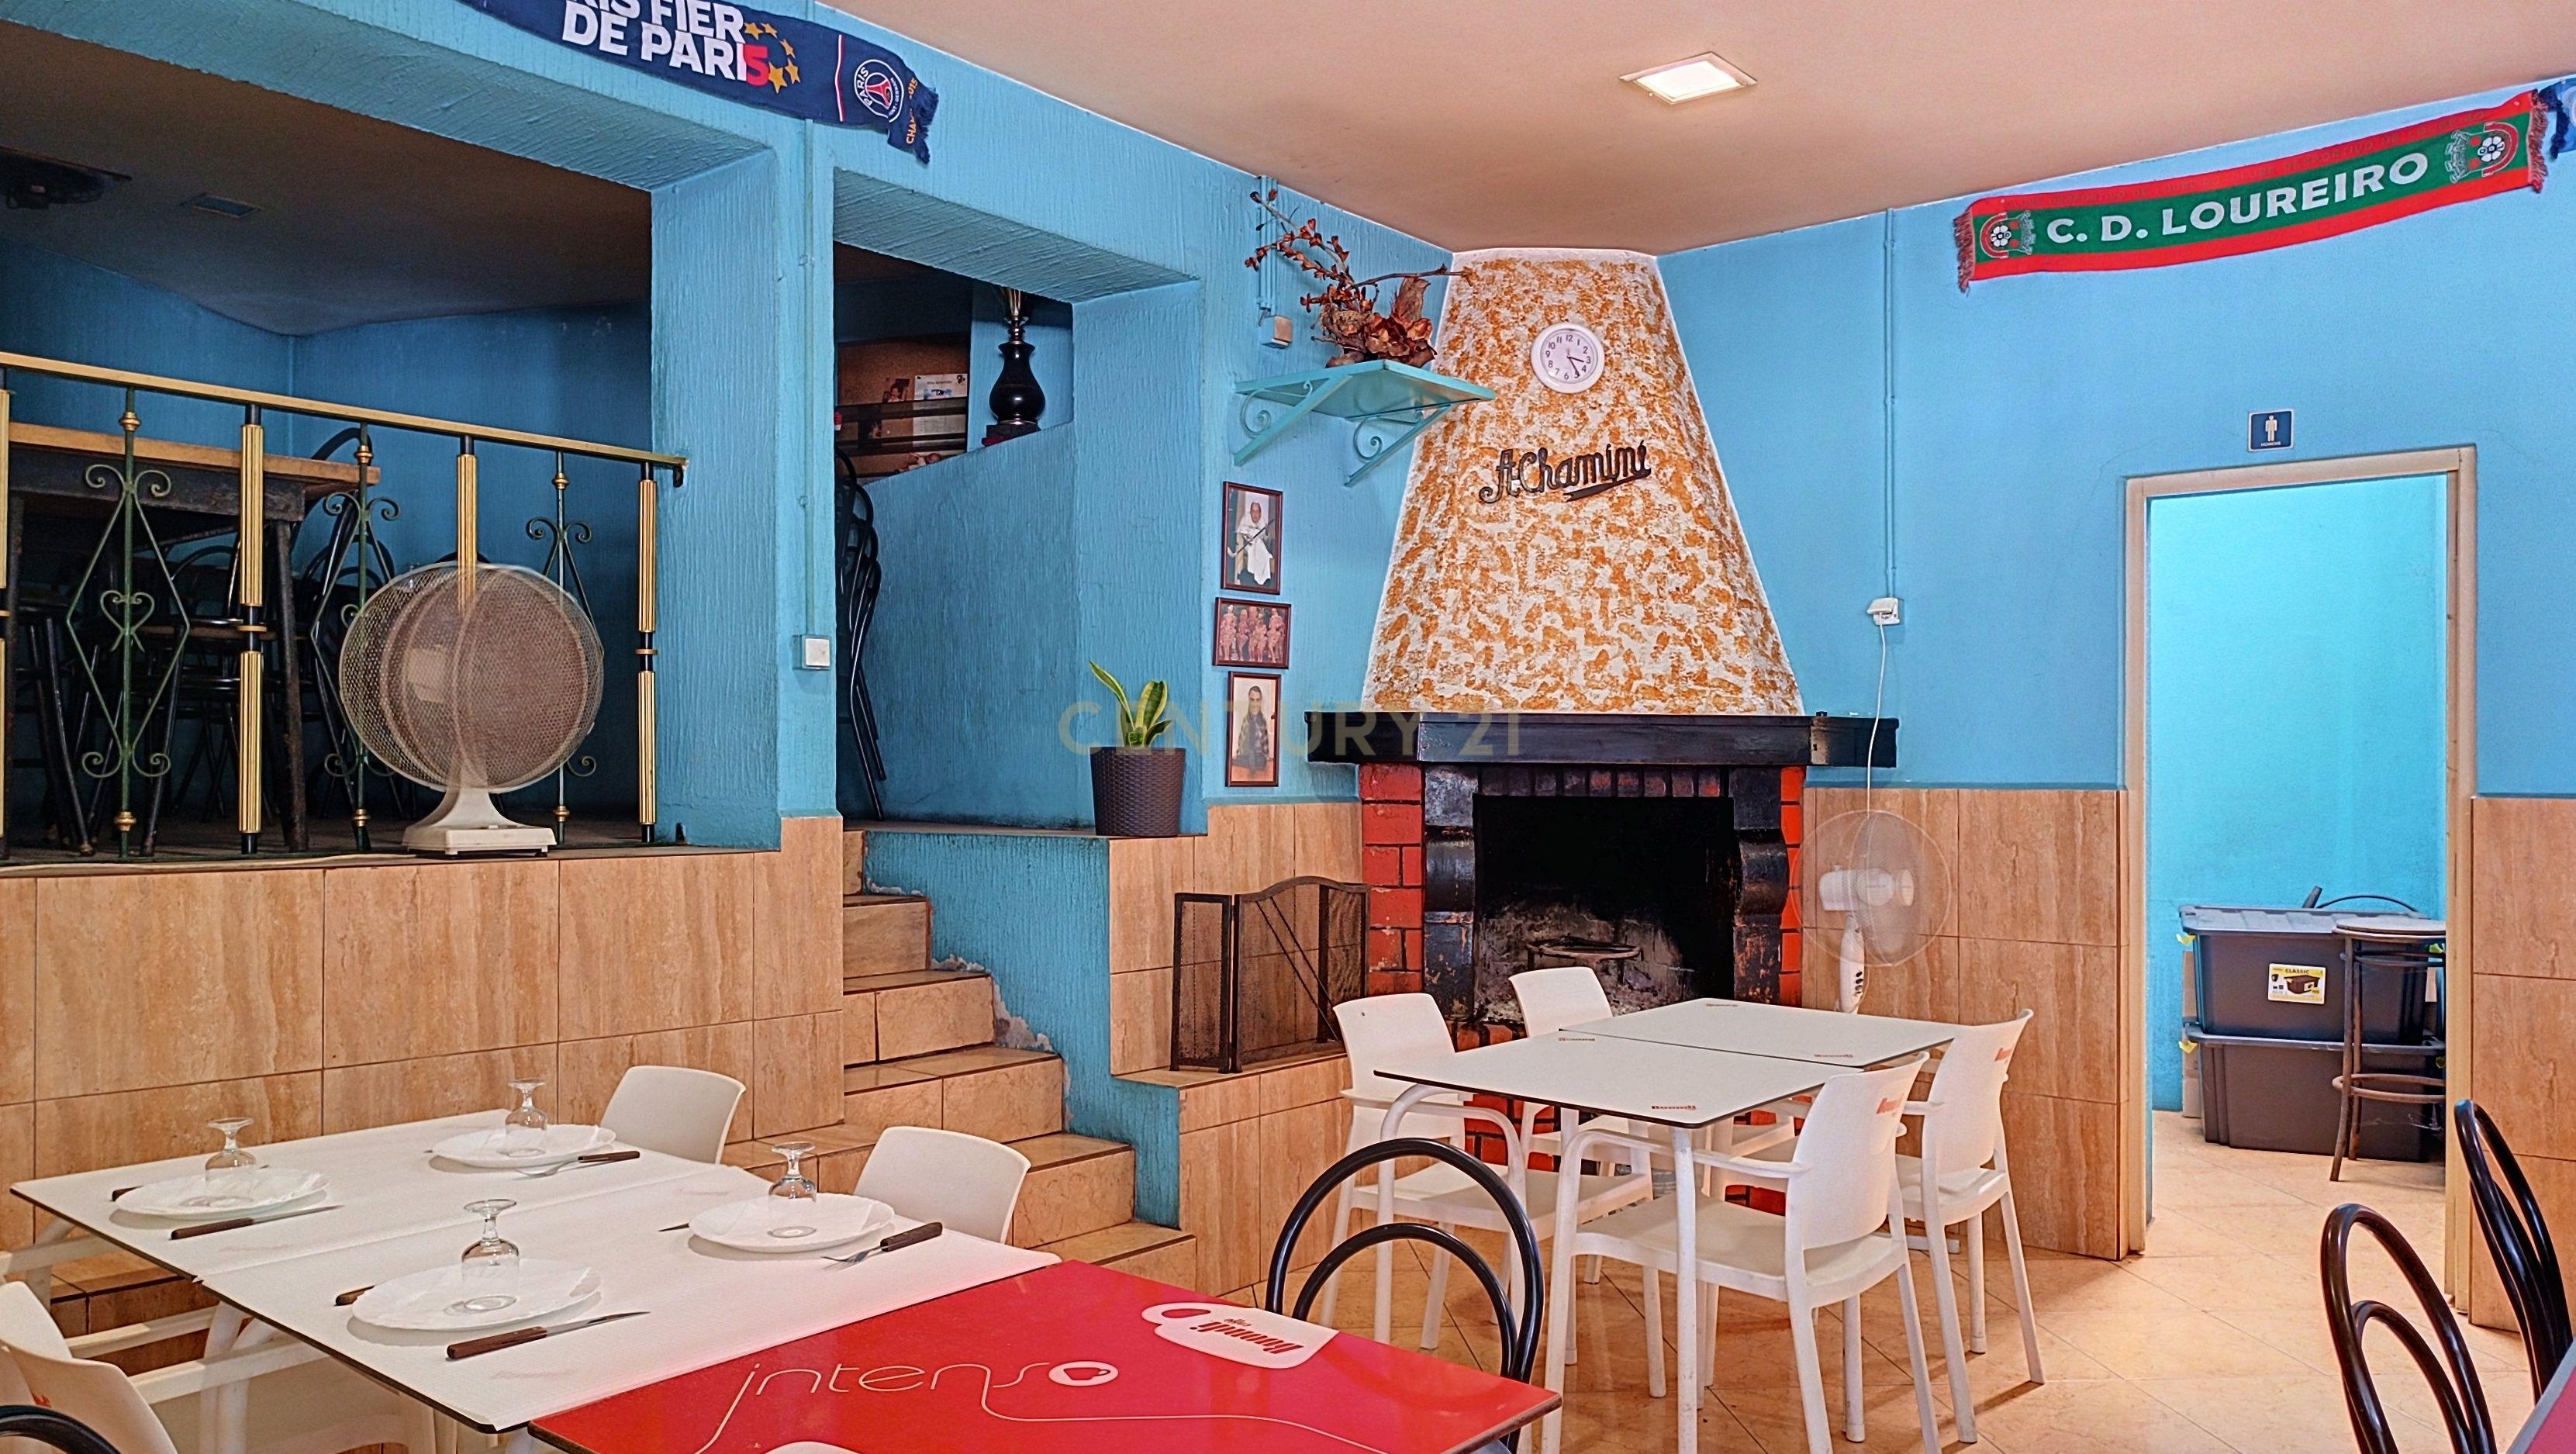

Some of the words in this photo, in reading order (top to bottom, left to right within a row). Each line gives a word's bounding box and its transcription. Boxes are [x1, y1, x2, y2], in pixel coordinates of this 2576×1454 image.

[562, 0, 628, 56] DE
[651, 0, 745, 43] FIER
[857, 67, 873, 106] PARIS
[907, 78, 918, 100] 015
[2046, 218, 2087, 243] C.
[2101, 215, 2148, 241] D.
[2162, 152, 2429, 236] LOUREIRO
